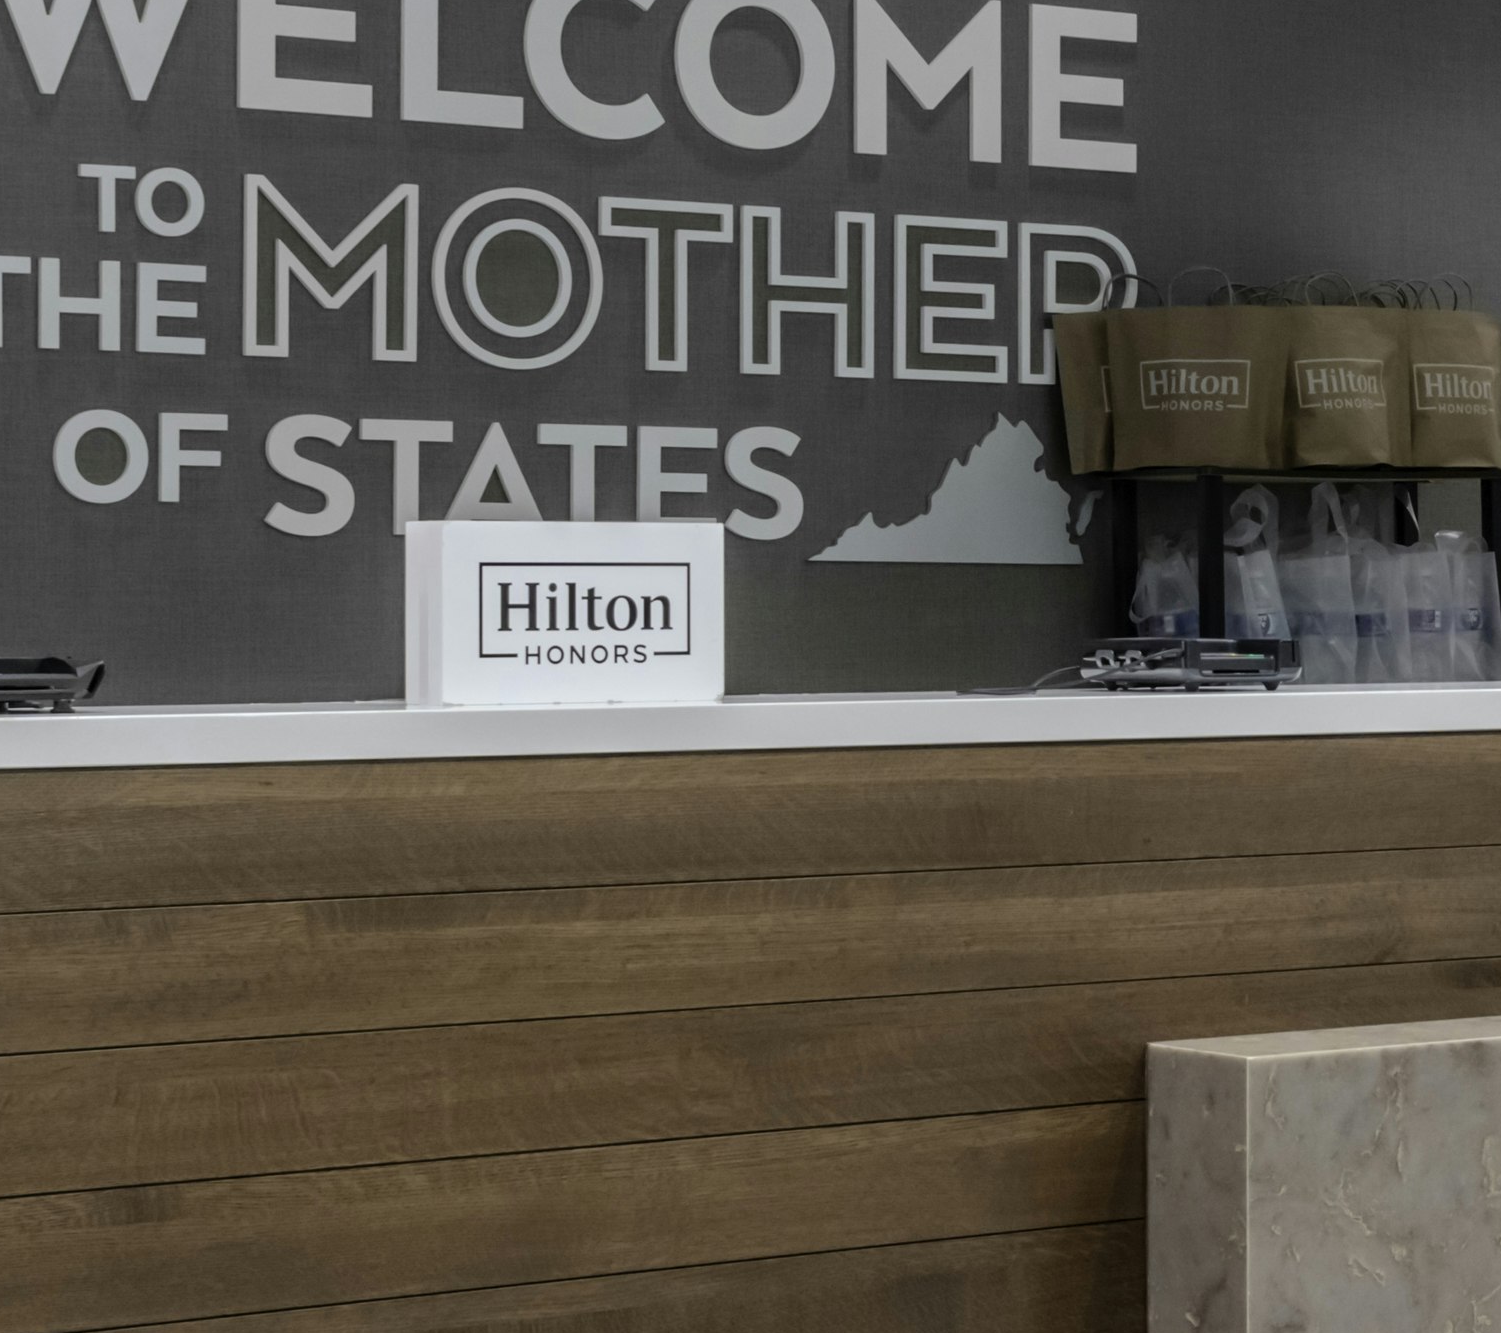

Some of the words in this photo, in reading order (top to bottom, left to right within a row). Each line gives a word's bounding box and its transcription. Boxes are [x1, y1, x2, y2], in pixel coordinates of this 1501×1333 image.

[77, 163, 205, 237] TO
[242, 174, 1138, 386] MOTHER
[1148, 369, 1239, 396] Hilton
[1306, 368, 1378, 395] Hilton
[1424, 373, 1492, 400] Hilton
[1161, 401, 1224, 411] HONORS
[1323, 398, 1375, 410] HONORS
[1437, 403, 1488, 415] HONORS
[52, 408, 229, 504] OF
[264, 413, 806, 541] STATES
[497, 582, 673, 632] Hilton
[524, 644, 648, 665] HONORS
